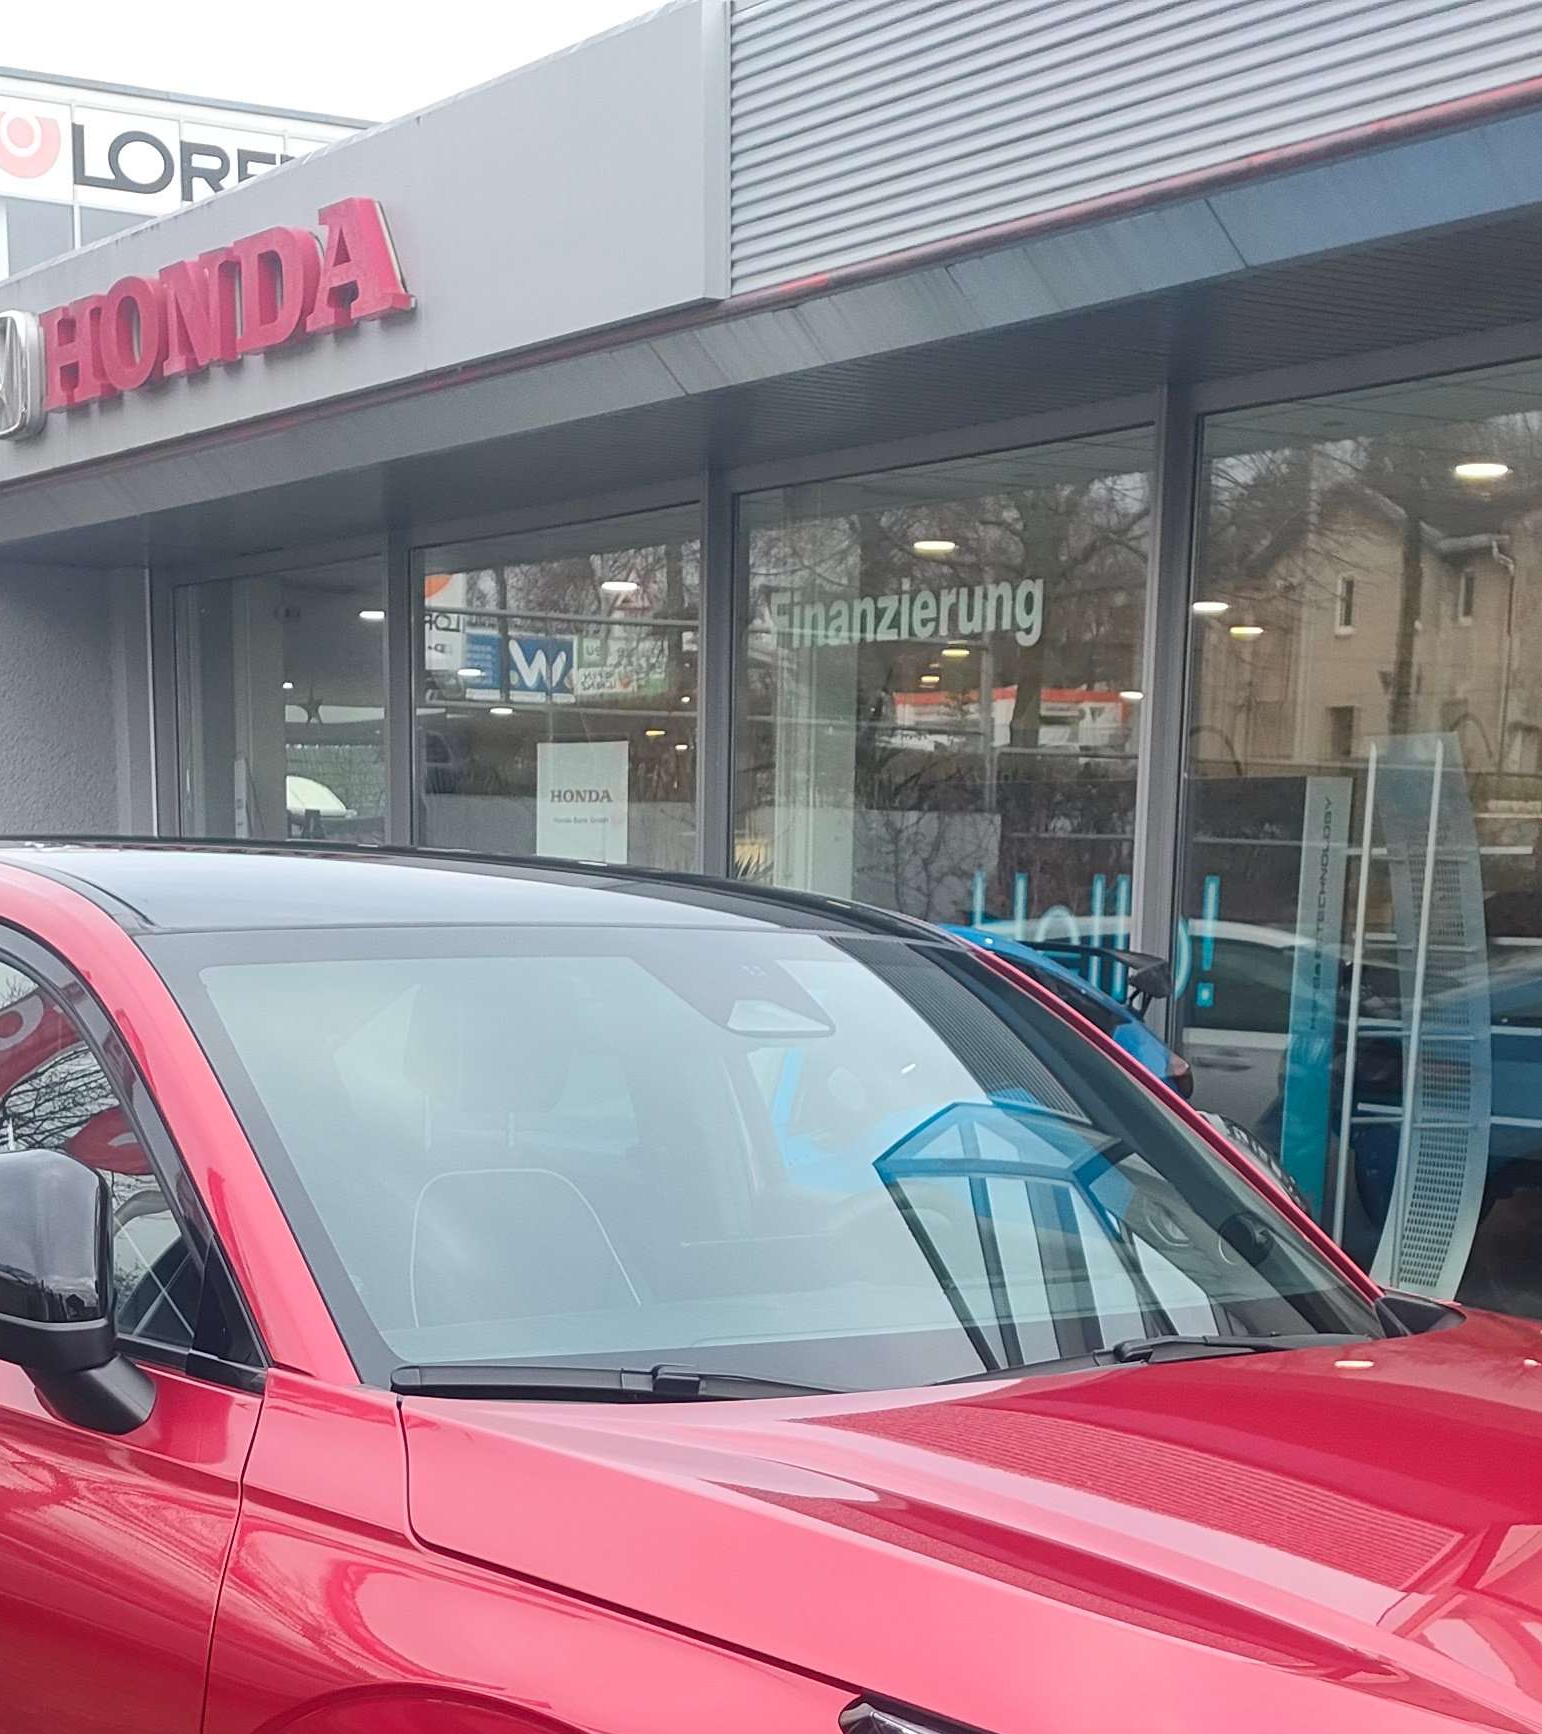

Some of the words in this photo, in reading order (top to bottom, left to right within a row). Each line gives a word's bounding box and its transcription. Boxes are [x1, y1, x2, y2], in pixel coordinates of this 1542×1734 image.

[72, 122, 295, 202] LORE
[41, 196, 416, 413] HONDA
[770, 577, 1044, 647] Finanzierung
[550, 789, 613, 803] HONDA
